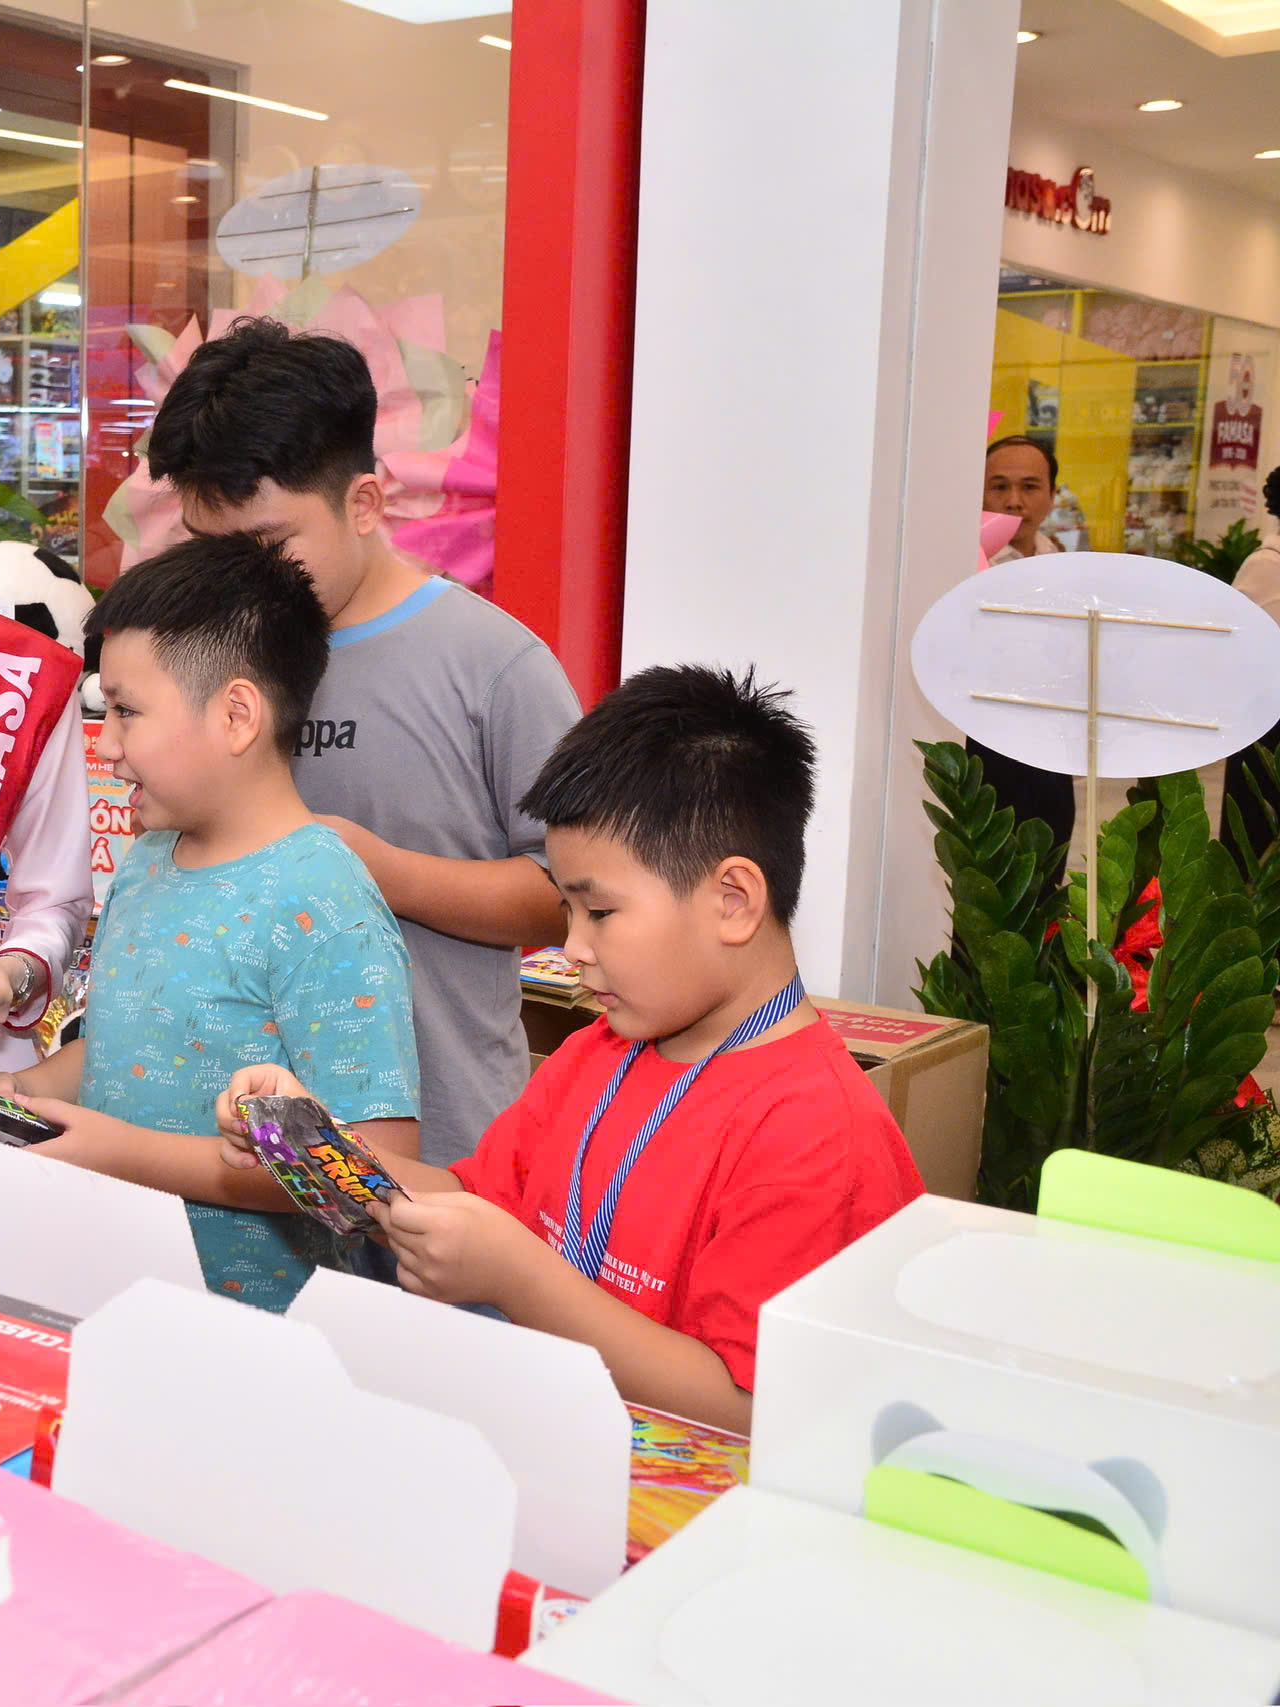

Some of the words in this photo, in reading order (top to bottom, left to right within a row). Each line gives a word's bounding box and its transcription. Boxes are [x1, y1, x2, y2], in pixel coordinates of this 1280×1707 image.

[1217, 420, 1255, 447] FAHASA
[293, 720, 357, 757] ppa
[90, 798, 134, 835] ÓN
[231, 953, 268, 970] DINOSAUR
[196, 1001, 219, 1012] LAKE
[205, 1022, 232, 1033] SWIM
[236, 1052, 262, 1062] TORCH
[370, 1103, 394, 1112] TORCH
[619, 1260, 638, 1279] WILL
[616, 1275, 636, 1293] FEEL
